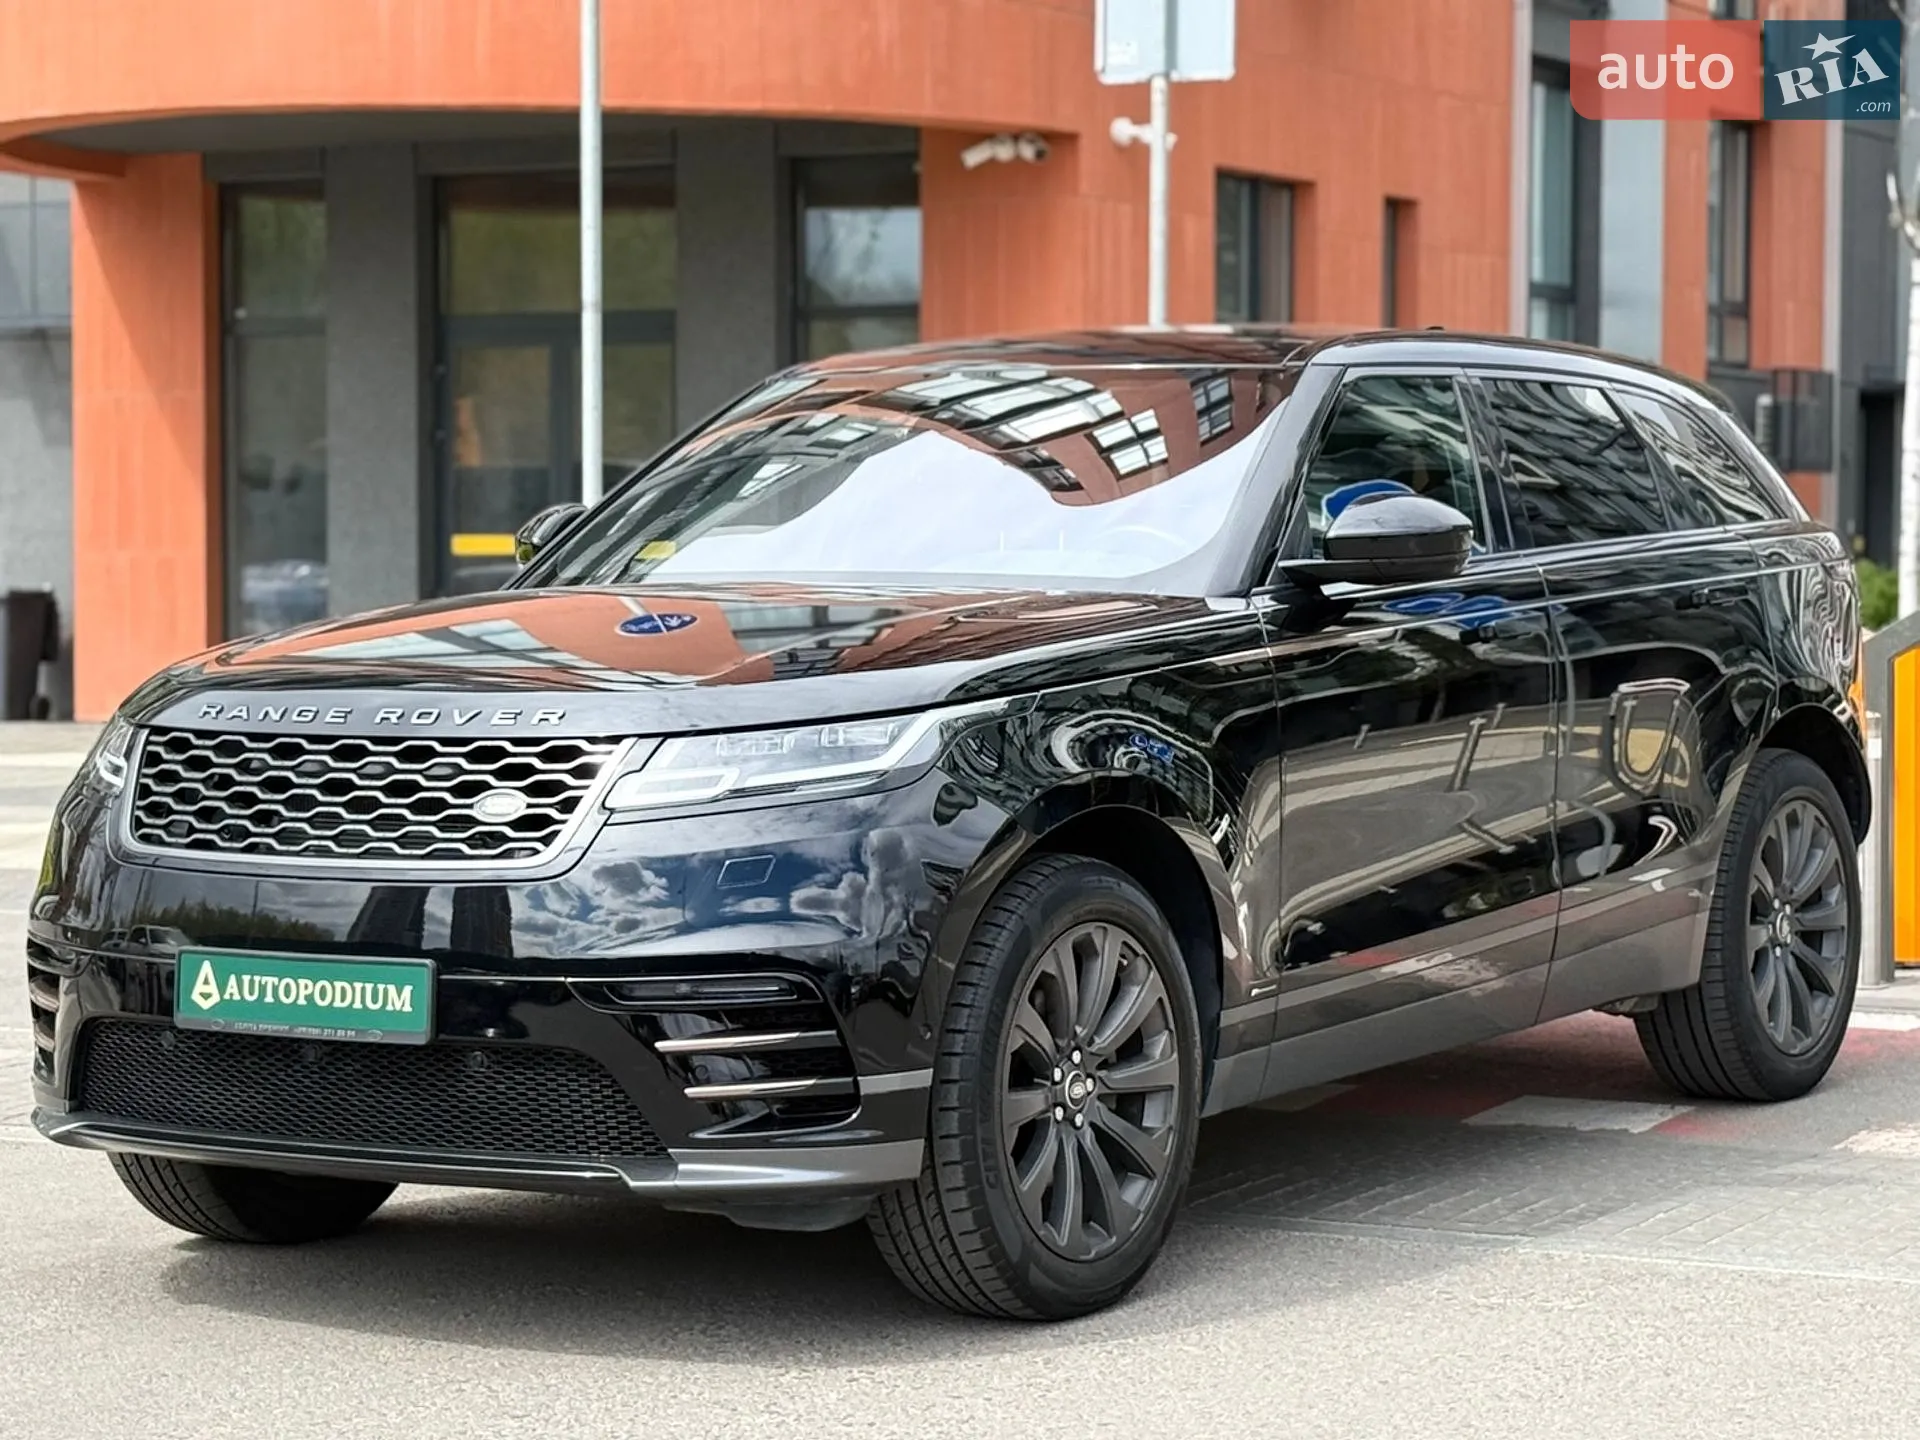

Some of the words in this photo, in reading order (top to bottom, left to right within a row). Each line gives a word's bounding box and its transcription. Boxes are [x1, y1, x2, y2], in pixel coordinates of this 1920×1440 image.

[198, 703, 353, 723] RANGE
[373, 707, 567, 726] ROVER
[223, 973, 413, 1012] AUTOPODIUM
